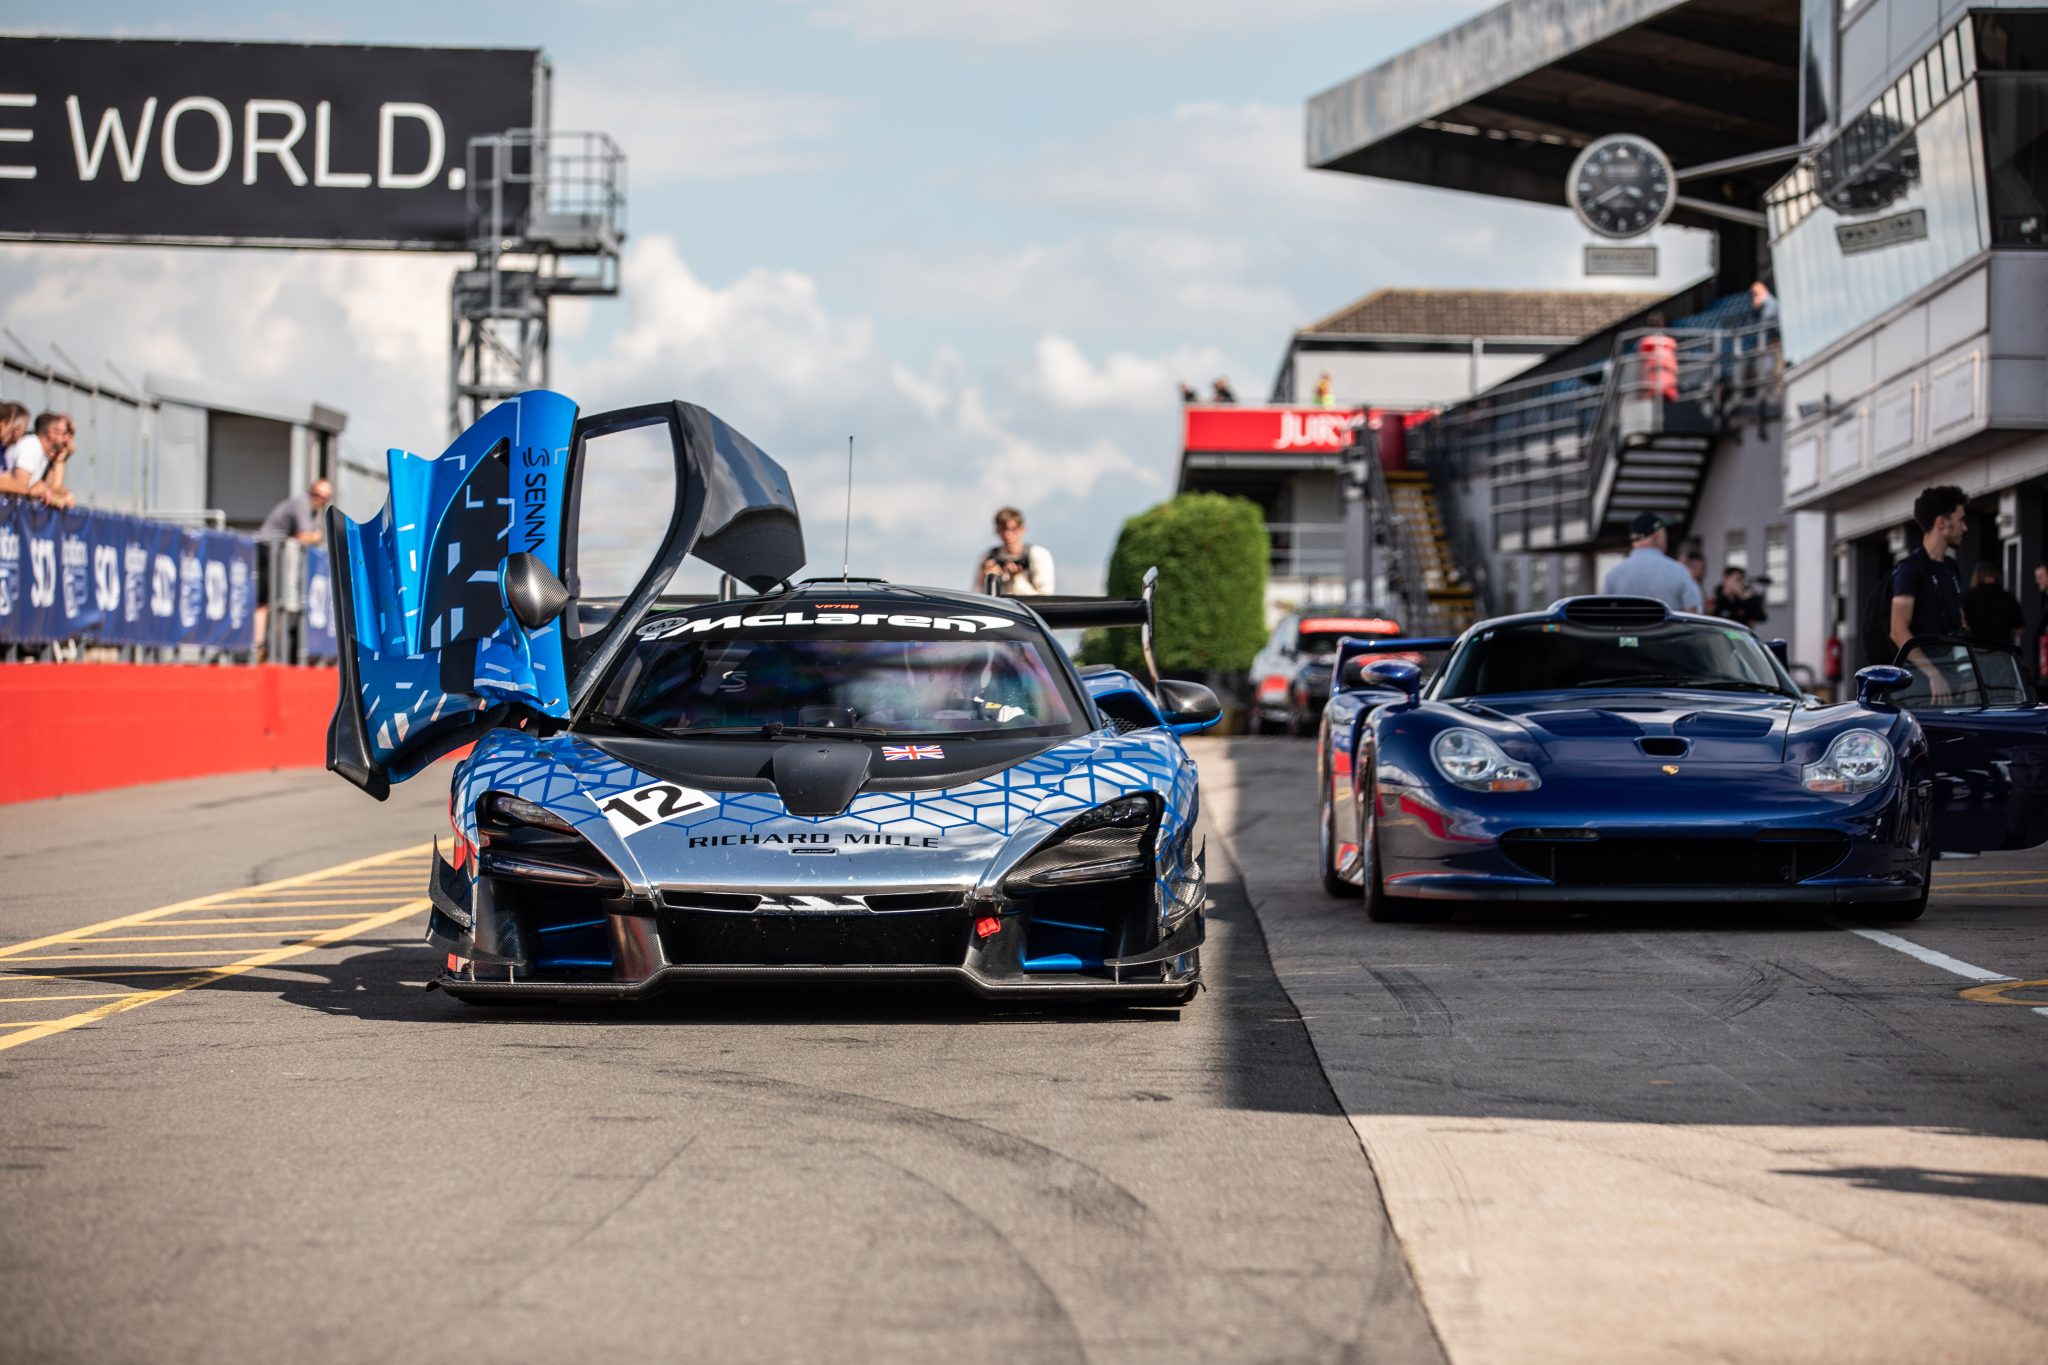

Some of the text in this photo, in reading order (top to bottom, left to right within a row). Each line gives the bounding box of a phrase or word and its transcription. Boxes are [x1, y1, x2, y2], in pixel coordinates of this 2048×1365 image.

[66, 94, 467, 191] WORLD.
[658, 612, 977, 640] McLaren
[602, 785, 705, 827] 12
[689, 833, 940, 849] RICHARD MILLE
